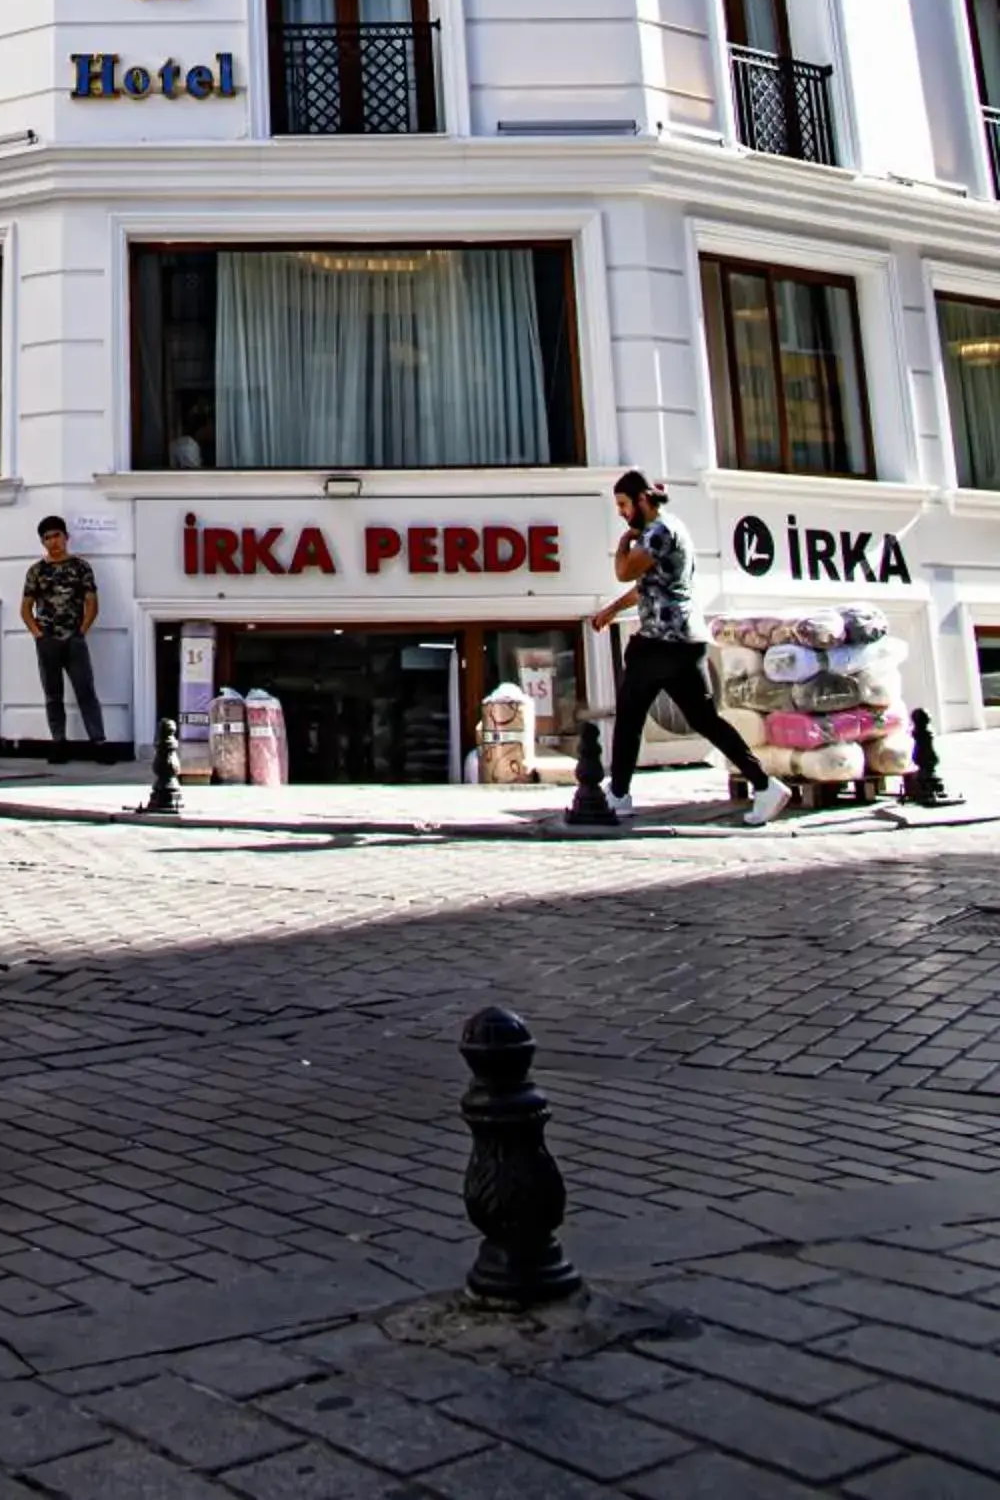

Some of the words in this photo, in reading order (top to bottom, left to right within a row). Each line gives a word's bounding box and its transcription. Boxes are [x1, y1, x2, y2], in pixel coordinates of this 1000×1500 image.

[70, 52, 237, 100] Hotel
[183, 512, 337, 576] İRKA
[364, 525, 561, 575] PERDE
[787, 514, 912, 584] İRKA
